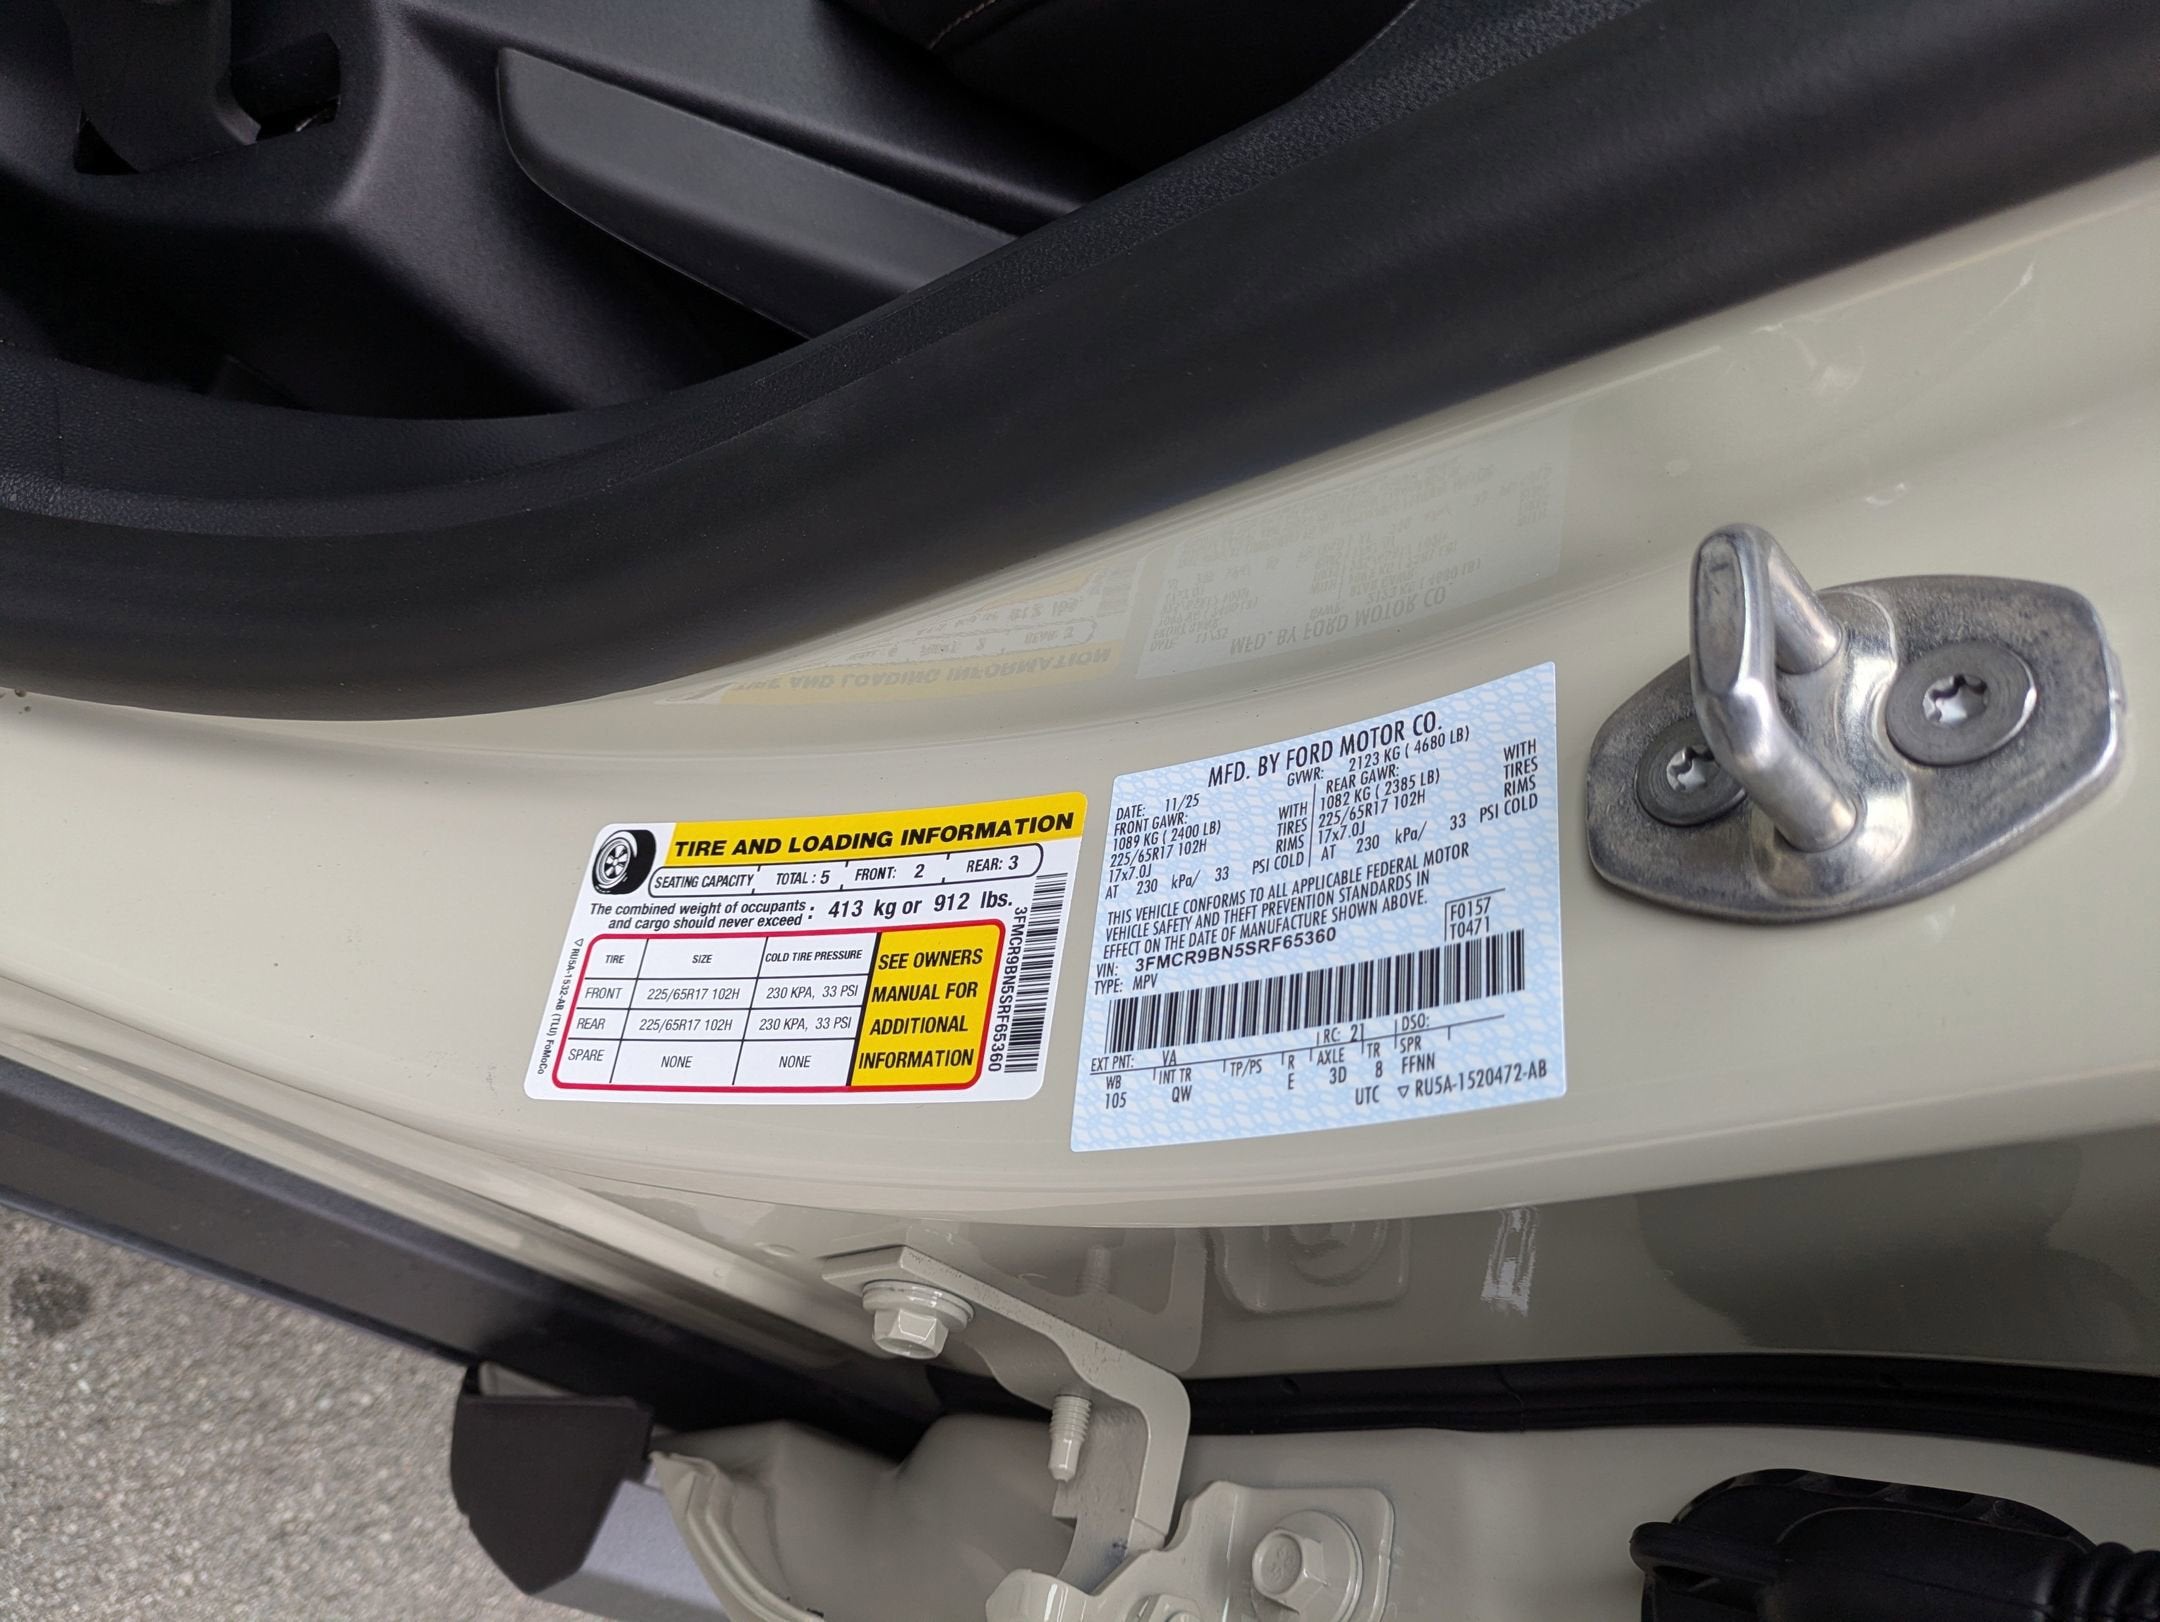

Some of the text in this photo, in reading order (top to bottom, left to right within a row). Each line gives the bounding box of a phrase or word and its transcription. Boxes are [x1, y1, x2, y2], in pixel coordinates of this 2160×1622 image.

[1208, 711, 1442, 787] MFD. BY FORD MOTOR CO.
[1287, 766, 1324, 786] GVWR:
[1349, 752, 1380, 773] 2123
[1383, 745, 1401, 762] KG
[1450, 725, 1470, 745] LB)
[1504, 739, 1536, 761] WITH
[1504, 756, 1538, 780] TIRES
[1326, 764, 1399, 794] REAR GAWR:
[1504, 775, 1536, 798] RIMS
[1321, 793, 1349, 811] 1082
[1354, 787, 1370, 804] KG
[1420, 768, 1440, 787] LB)
[1116, 793, 1200, 820] DATE: 11/25
[1278, 802, 1308, 820] WITH
[1318, 790, 1425, 828] 225/65R17 102H
[675, 812, 1074, 856] TIRE AND LOADING INFORMATION
[1114, 813, 1188, 836] FRONT GAWR:
[1278, 818, 1308, 837] TIRES
[1318, 821, 1365, 844] 17x7.0J
[1321, 793, 1538, 862] AT 230 kPa/ 33 PSI COLD
[1114, 834, 1139, 851] 1089
[1144, 831, 1158, 846] KG
[1203, 820, 1221, 835] LB)
[1276, 834, 1304, 854] RIMS
[1110, 839, 1207, 867] 225/65R17 102H
[855, 864, 925, 881] FRONT: 2
[967, 855, 1019, 873] REAR: 3
[1110, 865, 1151, 883] 17x7.0J
[655, 874, 754, 888] SEATING CAPACITY
[820, 871, 830, 884] 5
[1105, 852, 1304, 900] AT 230 kPa/ 33 PSI COLD
[1108, 842, 1469, 926] THIS VEHICLE CONFORMS TO ALL APPLICABLE FEDERAL MOTOR
[591, 900, 806, 916] The combined weight of occupants
[829, 891, 1013, 919] 413 kg or 912 lbs.
[1106, 869, 1430, 942] VEHICLE SAFETY AND THEFT PREVENTION STANDARDS IN
[1450, 897, 1491, 921] F0157
[608, 914, 802, 931] and cargo should never exceed
[1103, 889, 1428, 959] EFFECT ON THE DATE OF MANUFACTURE SHOWN ABOVE.
[1450, 916, 1490, 940] T0471
[605, 955, 625, 963] TIRE
[692, 955, 712, 963] SIZE
[765, 950, 862, 962] COLD TIRE PRESSURE
[878, 949, 983, 969] SEE OWNERS
[1097, 926, 1336, 978] VIN: 3FMCR9BN5SRF65360
[585, 987, 622, 999] FRONT
[648, 988, 740, 1002] 225/65R17 102H
[767, 985, 858, 999] 230 KPA, 33 PSI
[872, 982, 978, 1002] MANUAL FOR
[988, 907, 1028, 1072] 3FMCR9BN5SRF65360
[1095, 974, 1158, 996] TYPE: MPV
[547, 1013, 561, 1036] (TLU)
[577, 1018, 605, 1030] REAR
[639, 1019, 732, 1033] 225/65R17 102H
[759, 1017, 851, 1032] 230 KPA, 33 PSI
[870, 1015, 968, 1035] ADDITIONAL
[1367, 1042, 1380, 1058] TR
[1400, 1036, 1422, 1053] SPR
[538, 1040, 554, 1074] FoMoCo
[568, 1049, 604, 1062] SPARE
[661, 1056, 692, 1068] NONE
[779, 1056, 811, 1068] NONE
[859, 1049, 974, 1069] INFORMATION
[1091, 1050, 1177, 1072] EXT PNT: VA
[1288, 1055, 1295, 1069] R
[1317, 1047, 1345, 1066] AXLE
[1401, 1053, 1435, 1074] FFNN
[1159, 1068, 1192, 1085] INT TR
[1230, 1059, 1262, 1078] TP/PS
[1329, 1066, 1347, 1084] 3D
[1375, 1061, 1383, 1078] 8
[1415, 1059, 1547, 1097] RU5A-1520472-AB
[1106, 1075, 1121, 1090] WB
[1288, 1073, 1294, 1089] E
[1105, 1093, 1127, 1109] 105
[1172, 1085, 1193, 1103] QW
[1355, 1085, 1380, 1105] UTC
